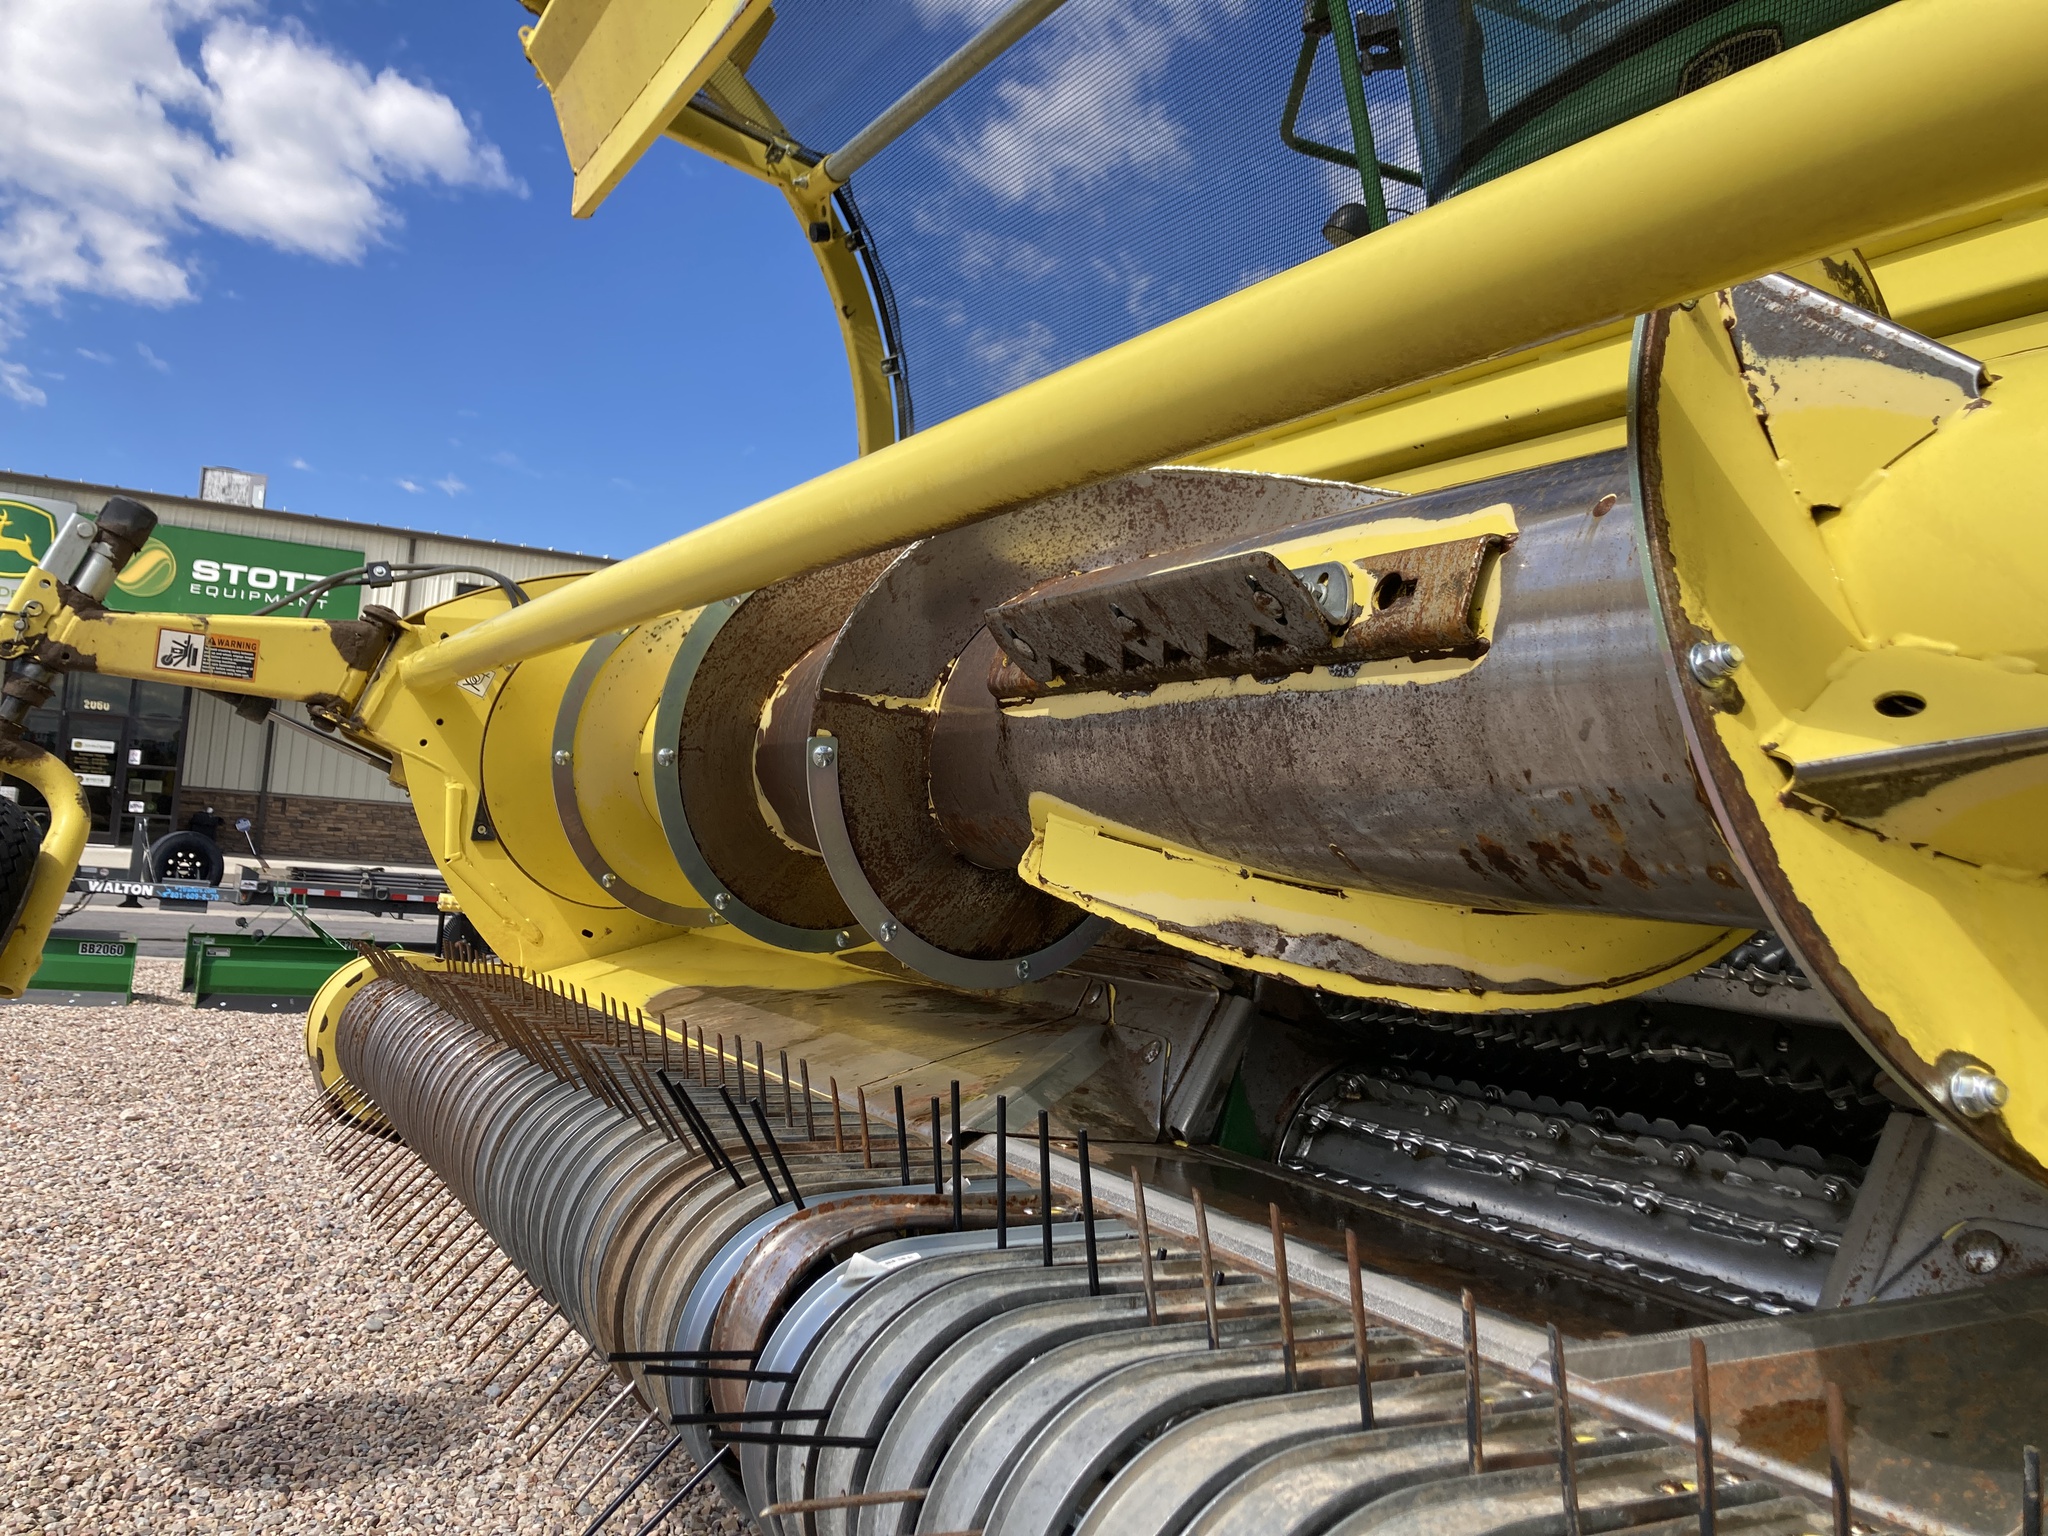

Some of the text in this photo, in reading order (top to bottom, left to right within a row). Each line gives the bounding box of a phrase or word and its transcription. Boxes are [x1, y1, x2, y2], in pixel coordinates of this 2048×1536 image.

[189, 583, 328, 610] EQUIPMNT
[217, 638, 257, 651] WARNING
[83, 699, 110, 711] 2060
[88, 880, 154, 896] WALTON
[170, 891, 219, 901] 801-609-870
[80, 943, 124, 955] BB2060
